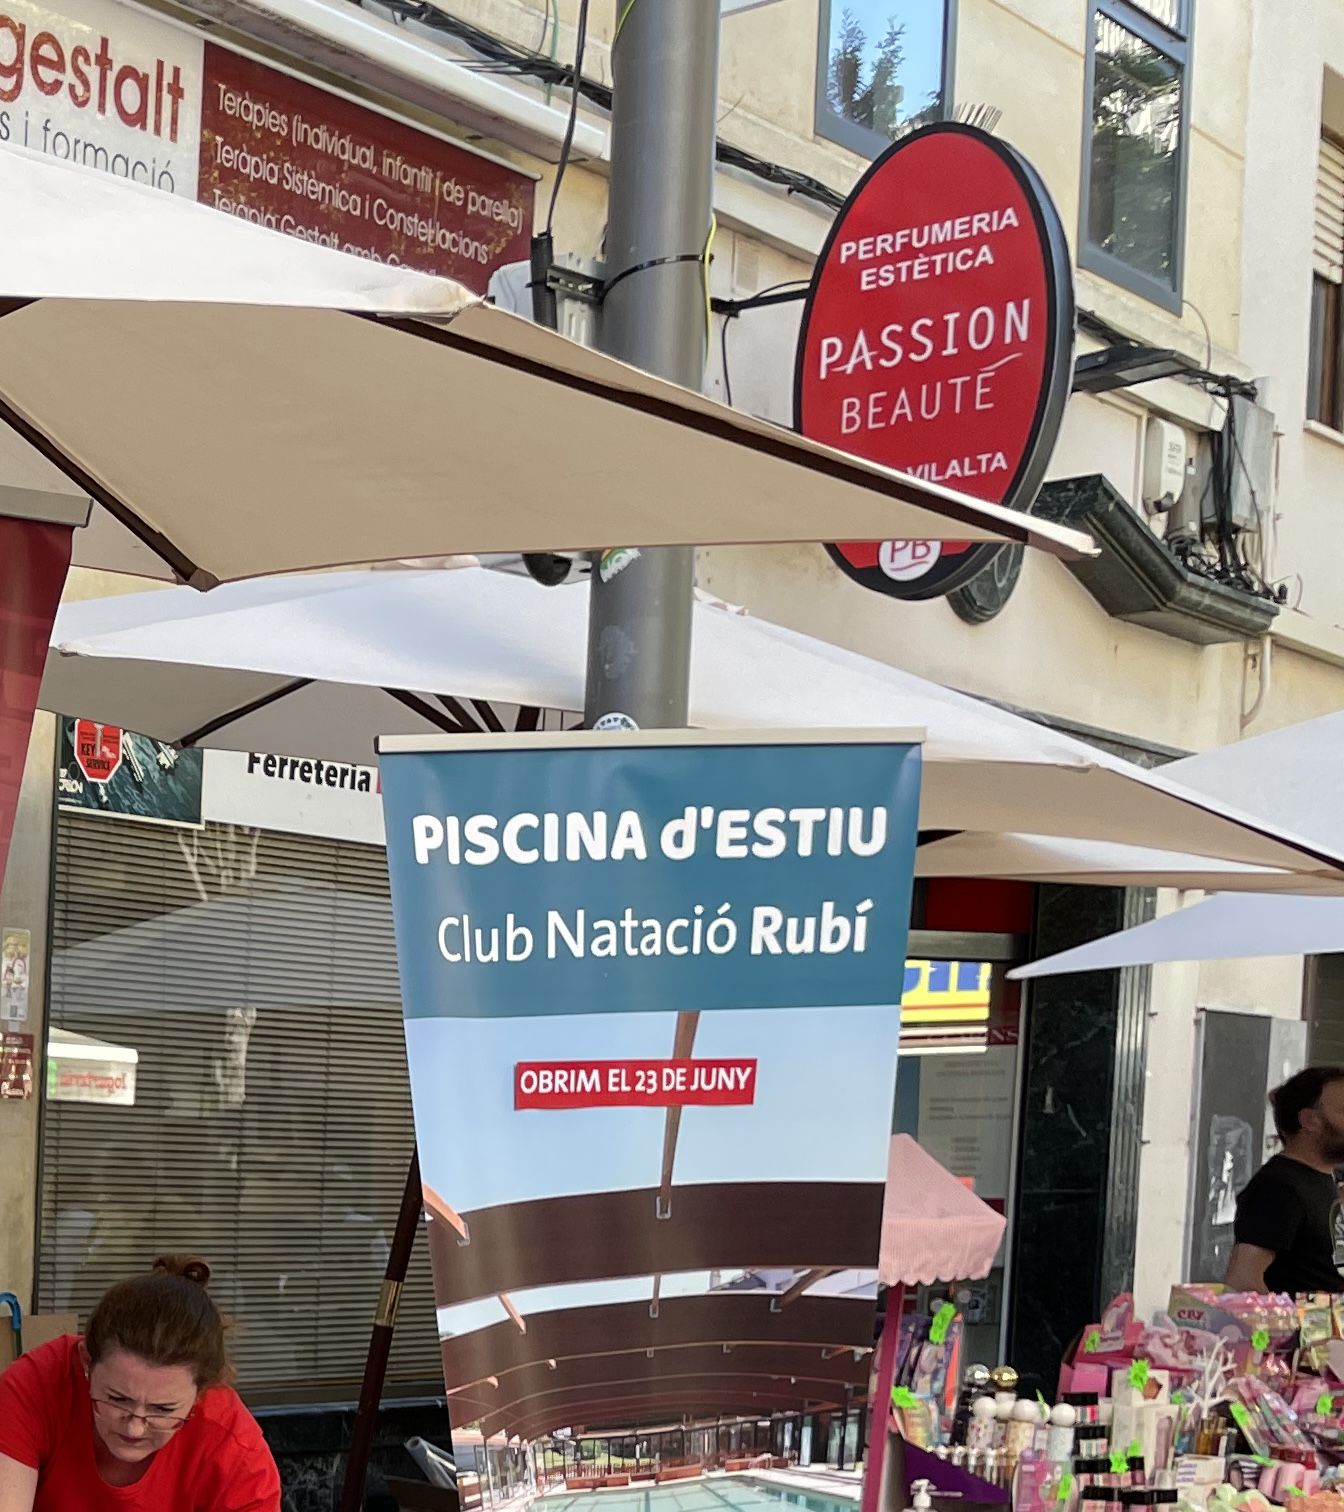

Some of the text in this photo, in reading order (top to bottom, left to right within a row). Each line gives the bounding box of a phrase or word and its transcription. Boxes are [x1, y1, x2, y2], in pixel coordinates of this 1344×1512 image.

[24, 111, 29, 147] i
[217, 83, 288, 137] Teràpies
[443, 176, 464, 206] de
[467, 184, 525, 235] parella)
[215, 136, 279, 185] Teràpia
[282, 162, 362, 212] Sistèmica
[840, 207, 1020, 264] PERFUMERIA
[860, 243, 994, 292] ESTÈTICA
[819, 299, 1032, 380] PASSION
[248, 751, 371, 793] Ferreteria
[412, 803, 888, 867] PISCINA d'ESTIU
[437, 897, 875, 967] Club Natació Rubí
[519, 1063, 753, 1097] OBRIM EL 23 DE JUNY
